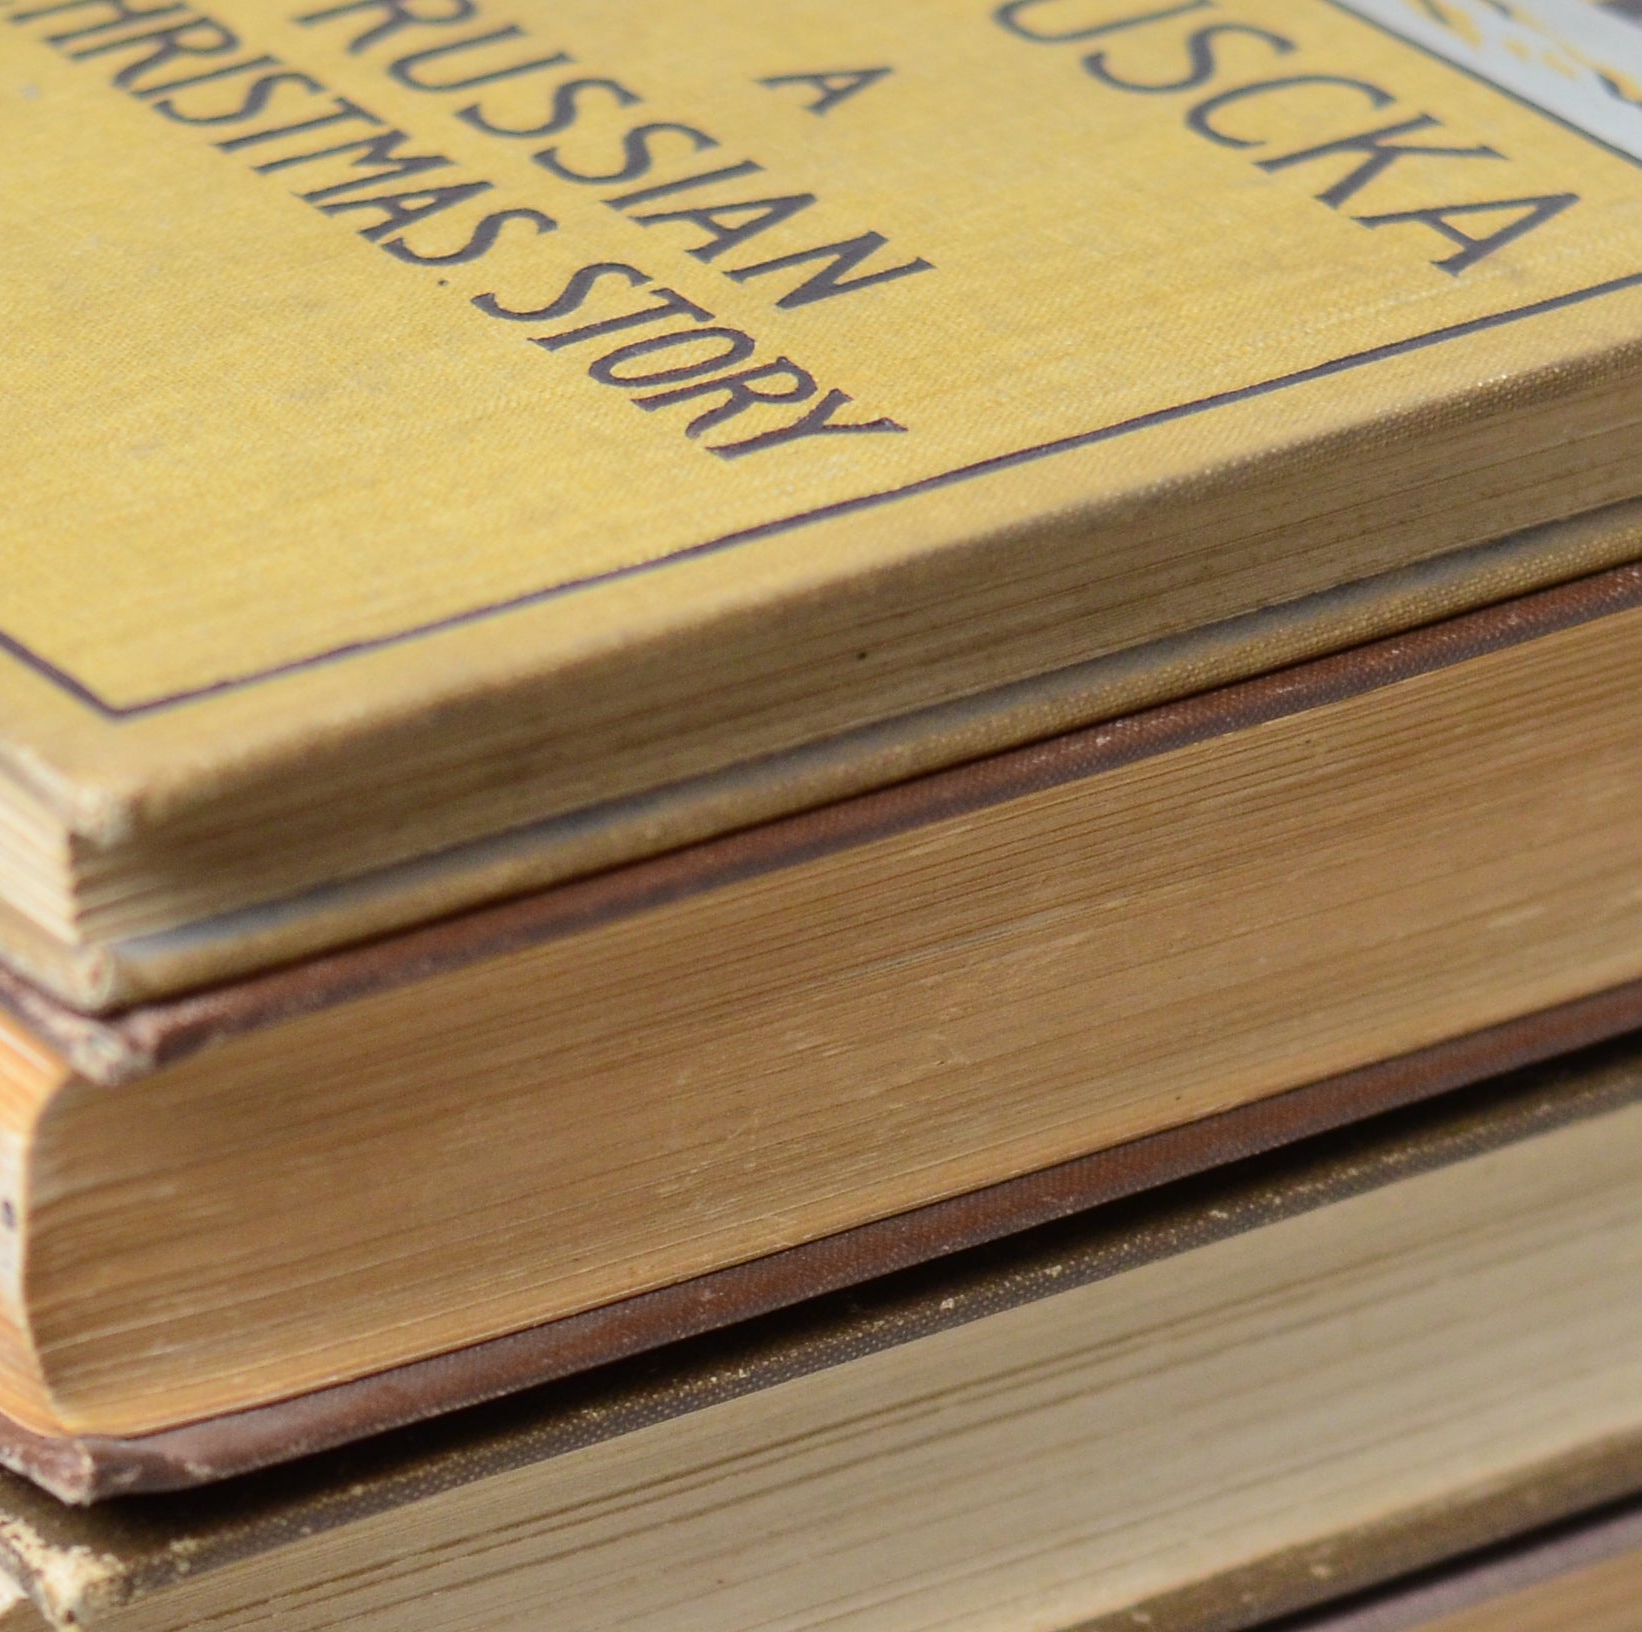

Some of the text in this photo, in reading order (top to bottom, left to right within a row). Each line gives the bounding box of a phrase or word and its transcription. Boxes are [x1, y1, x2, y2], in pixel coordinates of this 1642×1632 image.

[293, 0, 936, 311] RUSSIAN
[754, 66, 893, 116] A
[469, 262, 909, 461] STORY
